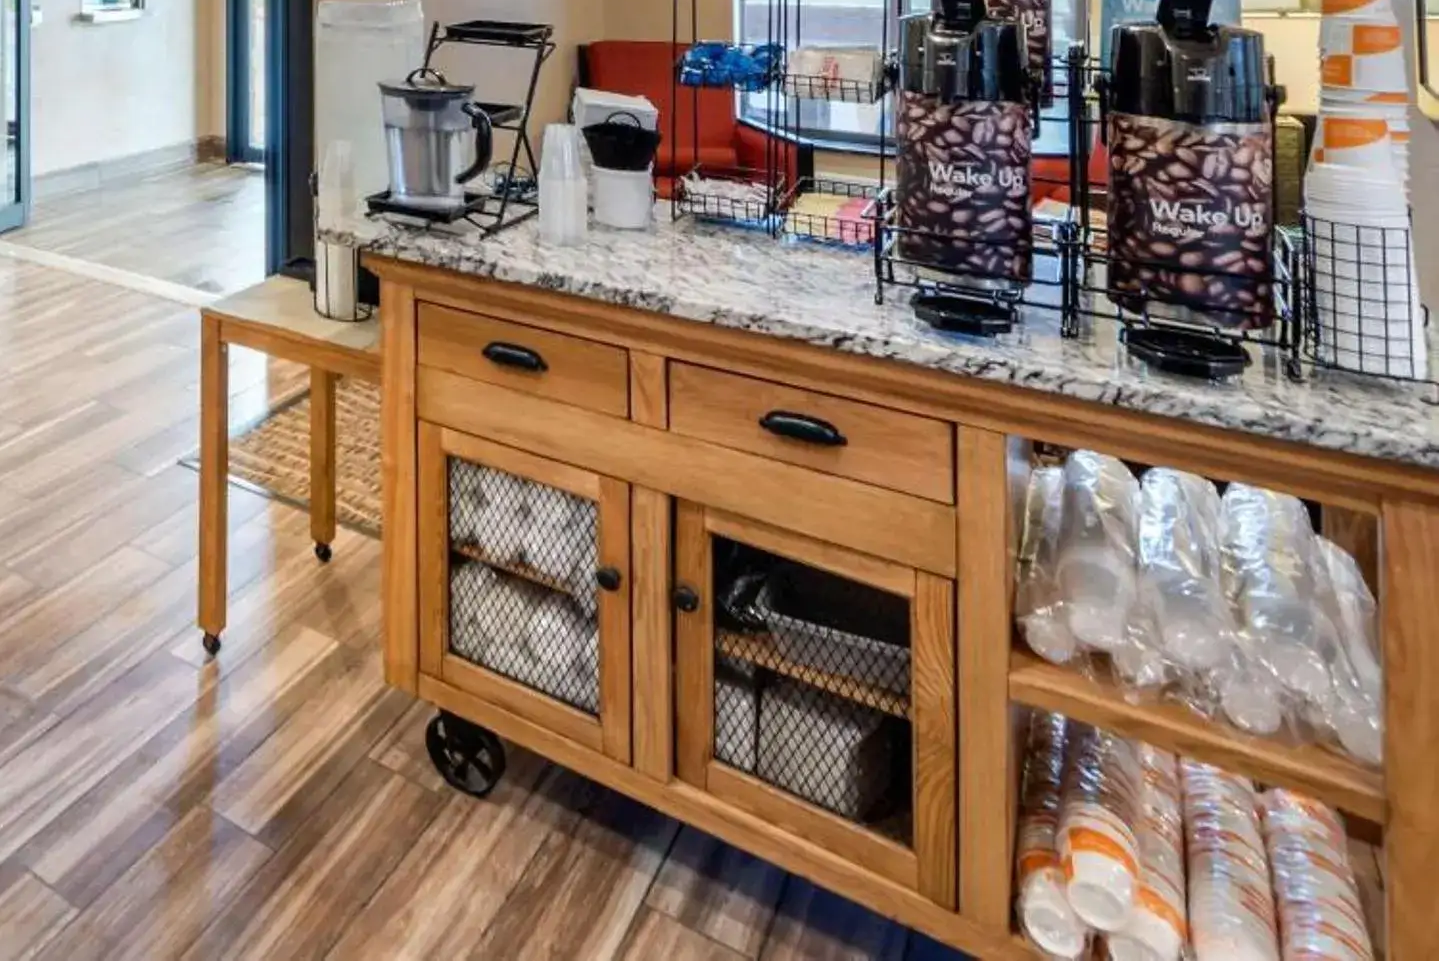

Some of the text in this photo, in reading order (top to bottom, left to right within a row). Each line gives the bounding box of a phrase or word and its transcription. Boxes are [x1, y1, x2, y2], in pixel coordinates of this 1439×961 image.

[928, 161, 1024, 192] Wake Up
[1149, 198, 1264, 233] Wake Up
